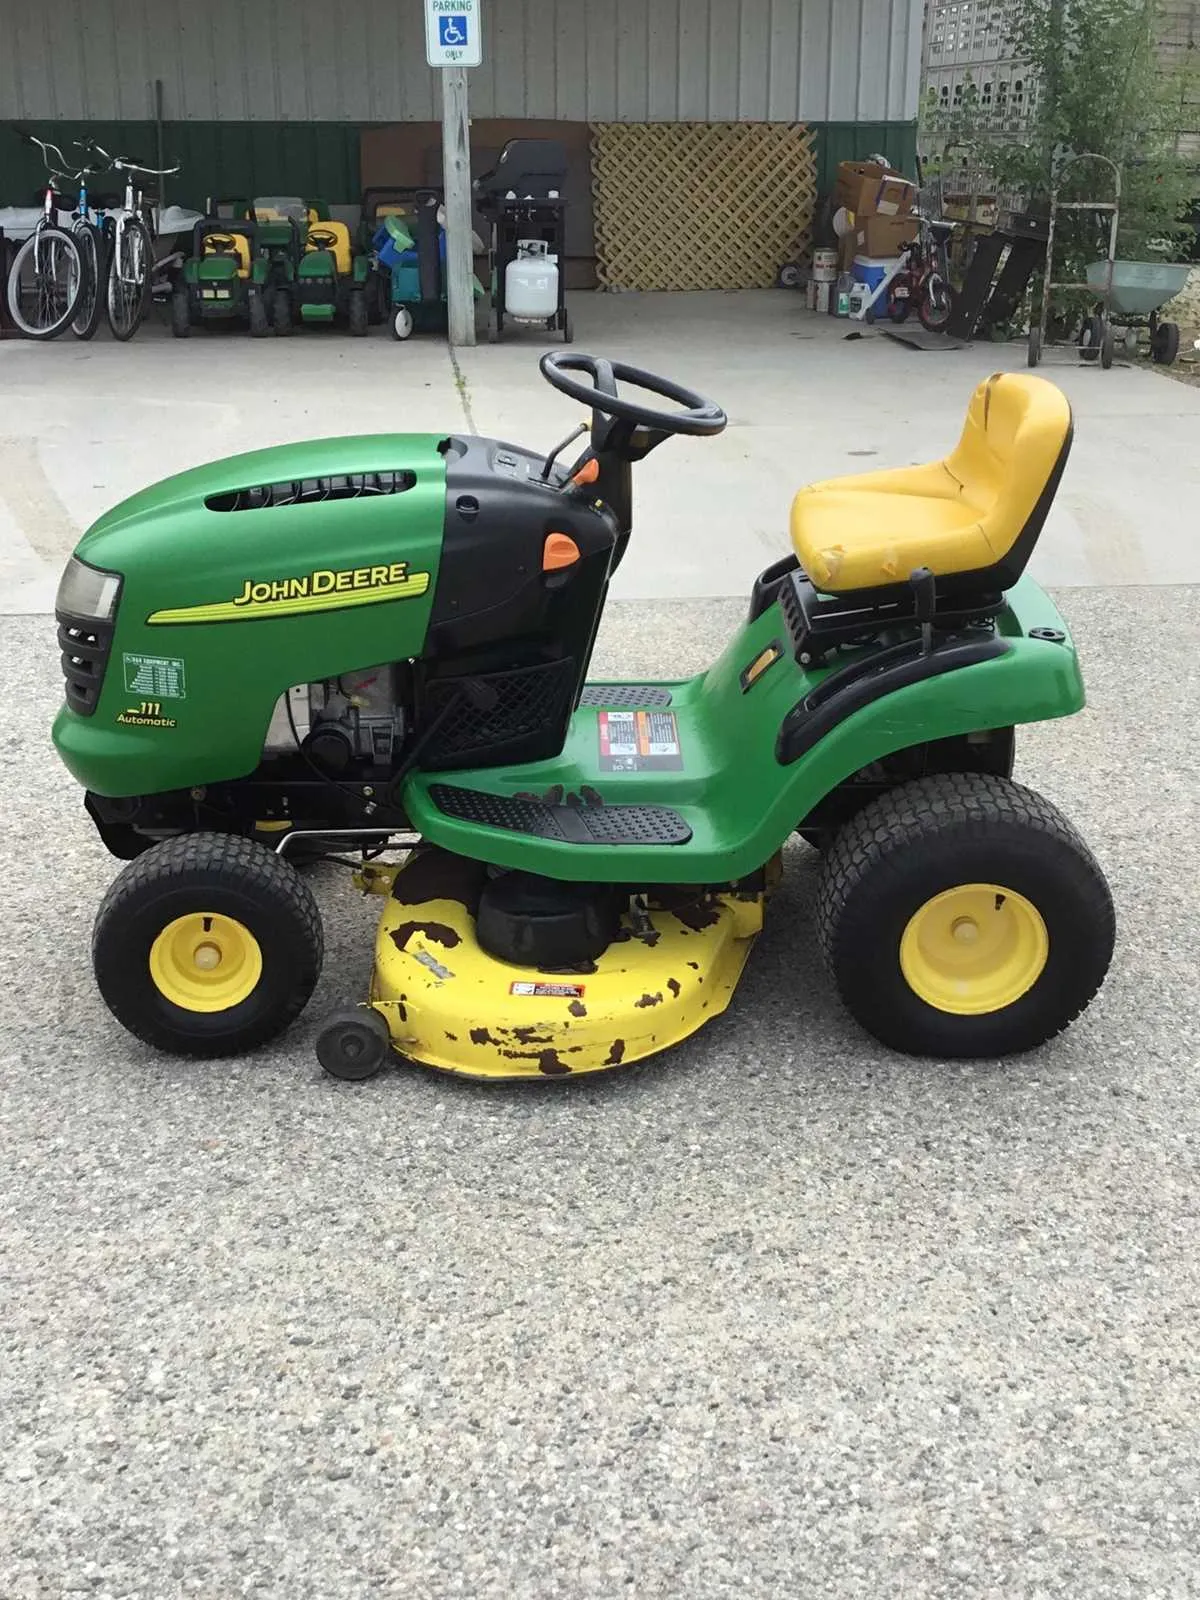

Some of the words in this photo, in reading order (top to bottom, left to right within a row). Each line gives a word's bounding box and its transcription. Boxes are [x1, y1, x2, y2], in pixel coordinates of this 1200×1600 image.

[432, 0, 473, 11] PARKING
[445, 50, 464, 59] ONLY
[234, 577, 309, 606] JOHN
[312, 562, 407, 595] DEERE
[140, 702, 161, 716] 111
[116, 713, 177, 728] Automatic
